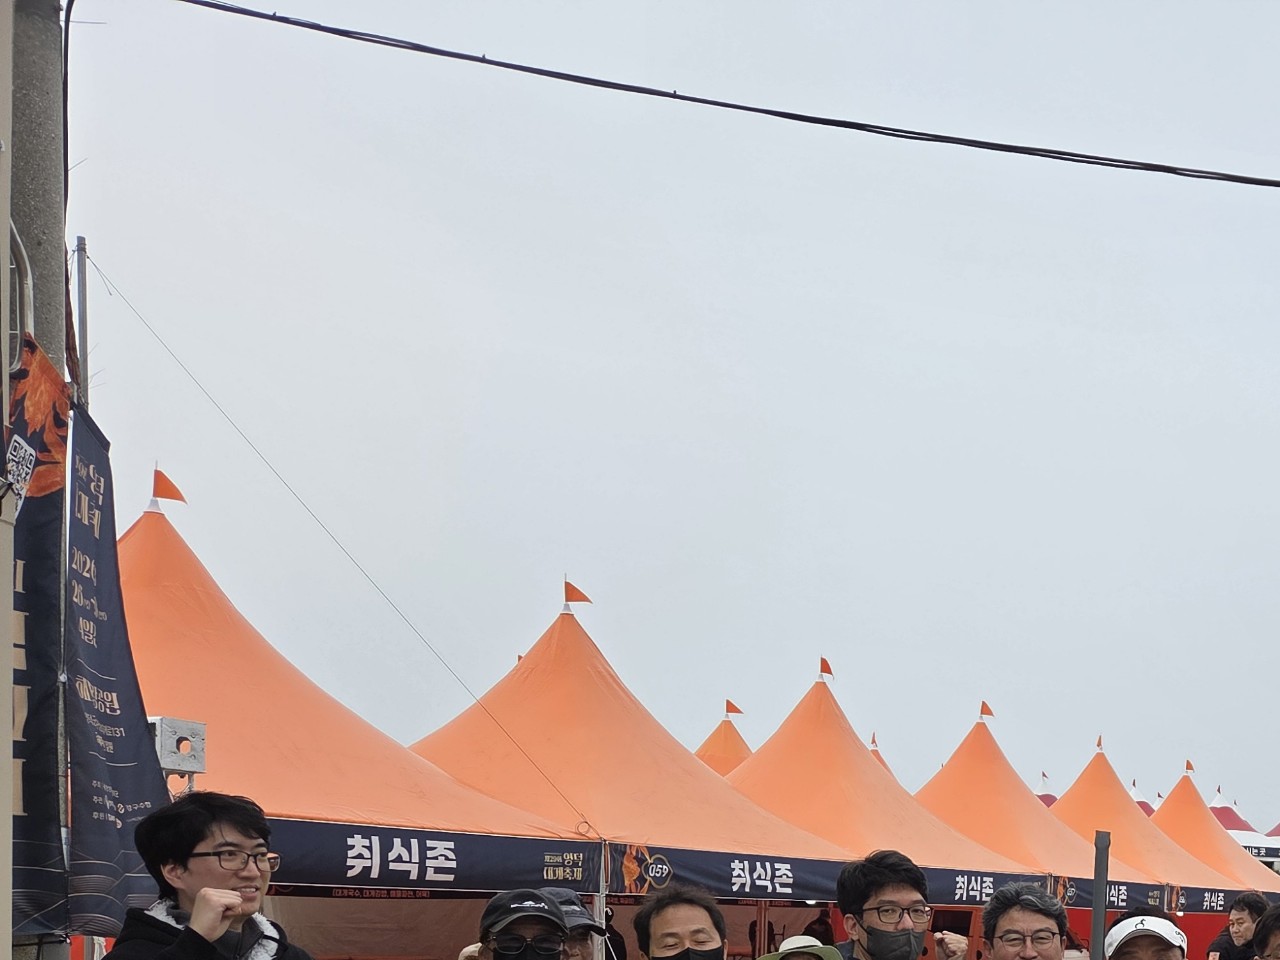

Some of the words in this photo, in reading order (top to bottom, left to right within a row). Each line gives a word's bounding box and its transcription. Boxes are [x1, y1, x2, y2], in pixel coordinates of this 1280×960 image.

[346, 834, 457, 881] 취식존
[563, 852, 583, 867] 영덕
[648, 865, 669, 878] 059
[730, 860, 794, 894] 취식존
[954, 875, 994, 901] 취식존
[1106, 885, 1128, 907] 식존
[1202, 891, 1225, 911] 취식존
